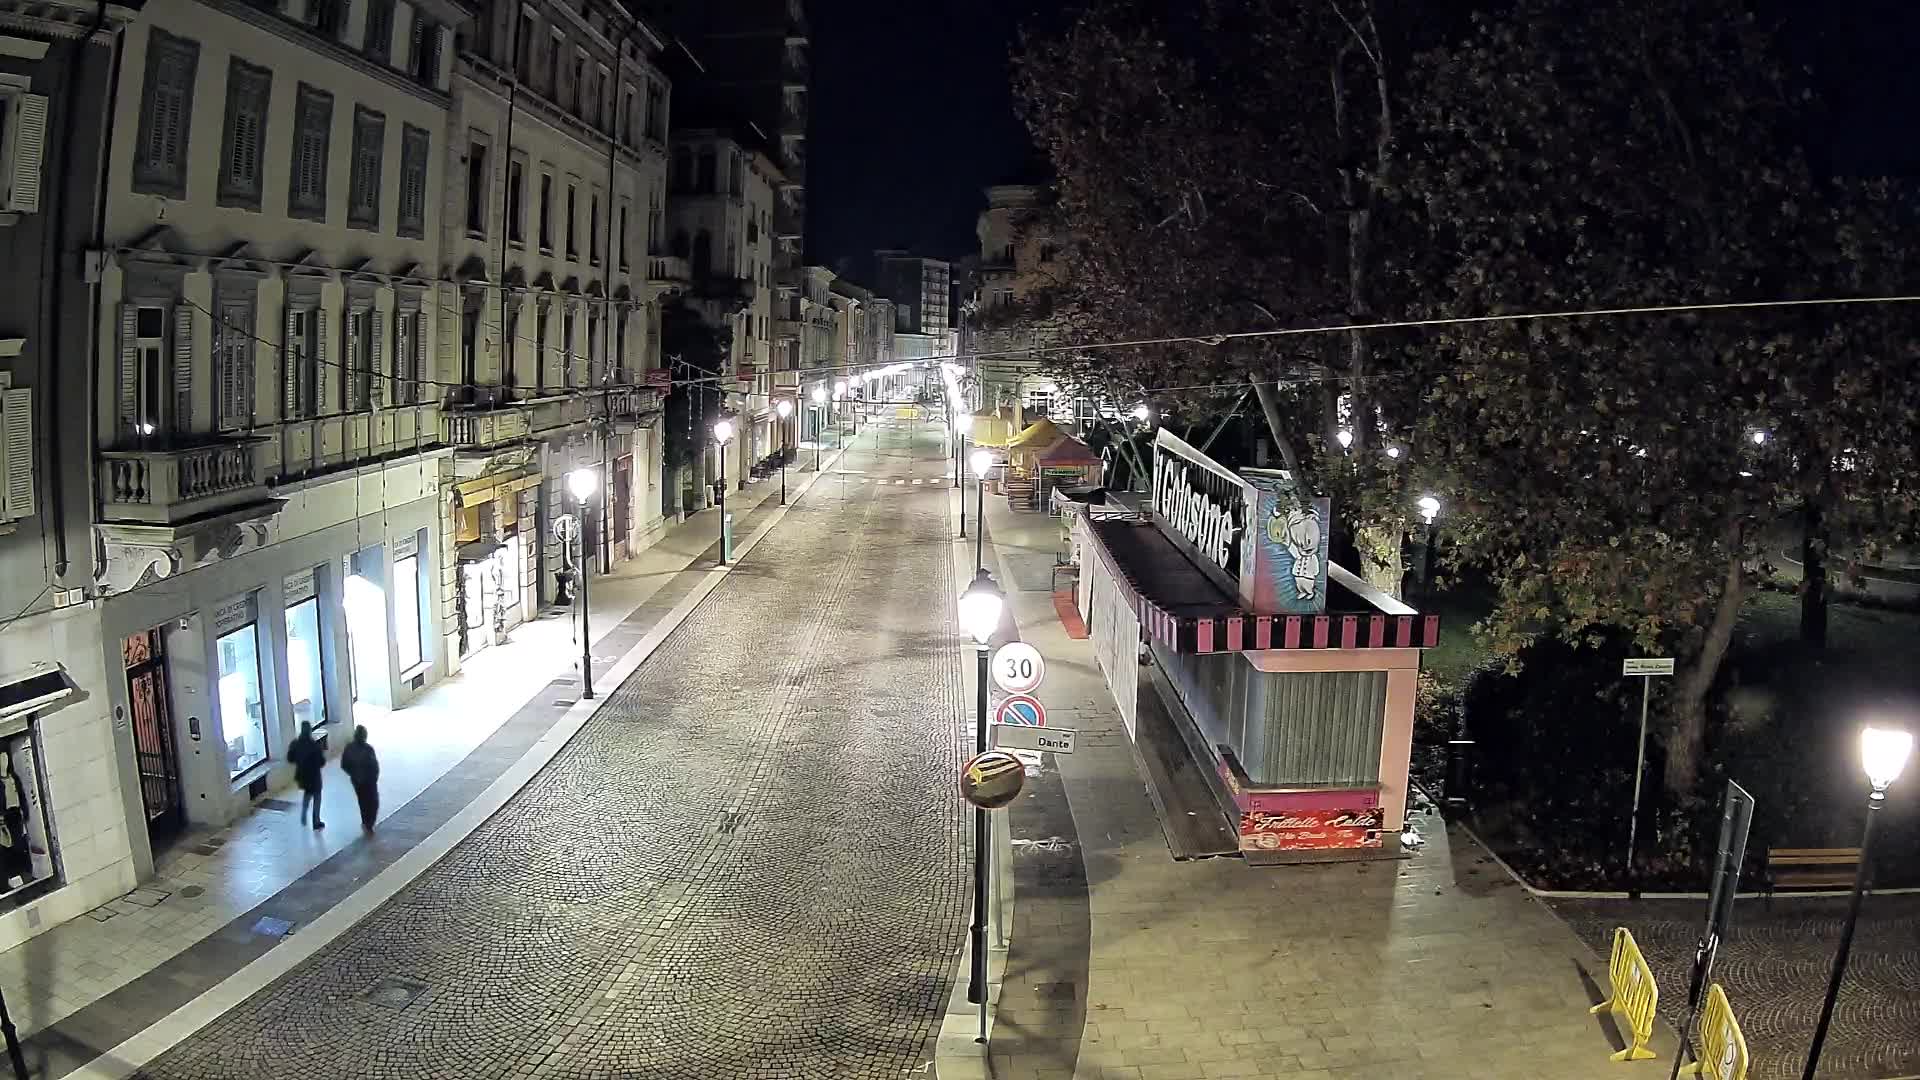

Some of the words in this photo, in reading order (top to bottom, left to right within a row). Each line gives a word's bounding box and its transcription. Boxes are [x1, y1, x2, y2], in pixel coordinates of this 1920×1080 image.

[1162, 459, 1232, 568] Golosone
[1006, 658, 1032, 678] 30
[1038, 737, 1069, 749] Dante
